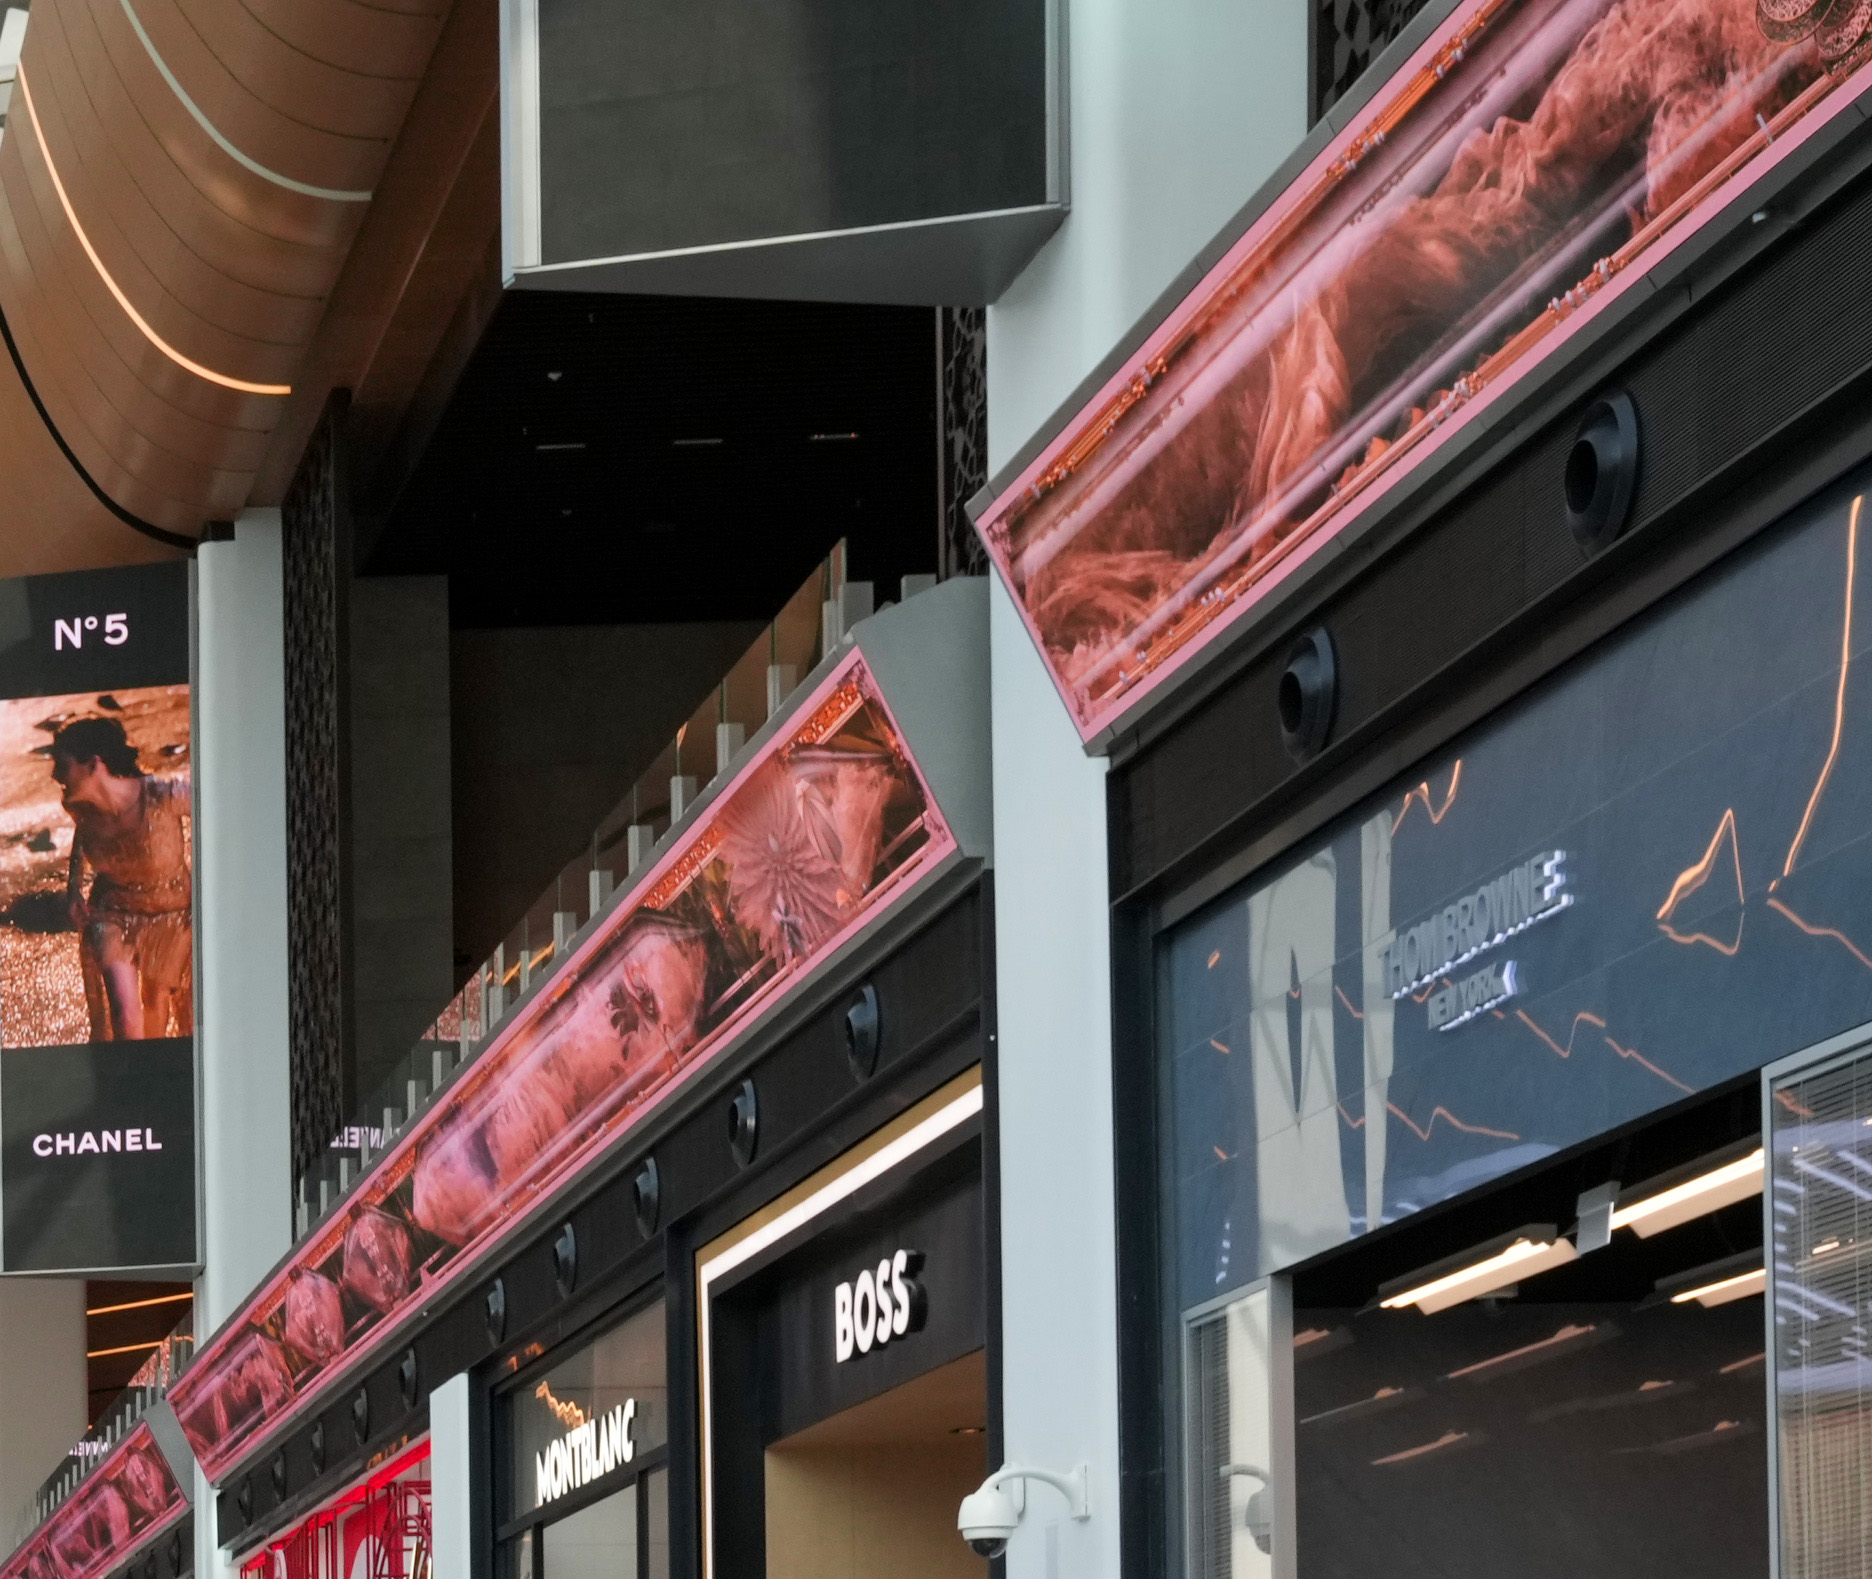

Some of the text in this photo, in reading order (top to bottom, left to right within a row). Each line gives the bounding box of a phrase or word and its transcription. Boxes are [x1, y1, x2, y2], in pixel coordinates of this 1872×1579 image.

[1443, 849, 1575, 968] BROWNE
[32, 1128, 164, 1157] CHANEL
[834, 1249, 914, 1363] BOSS
[535, 1398, 637, 1508] MONTBLANC
